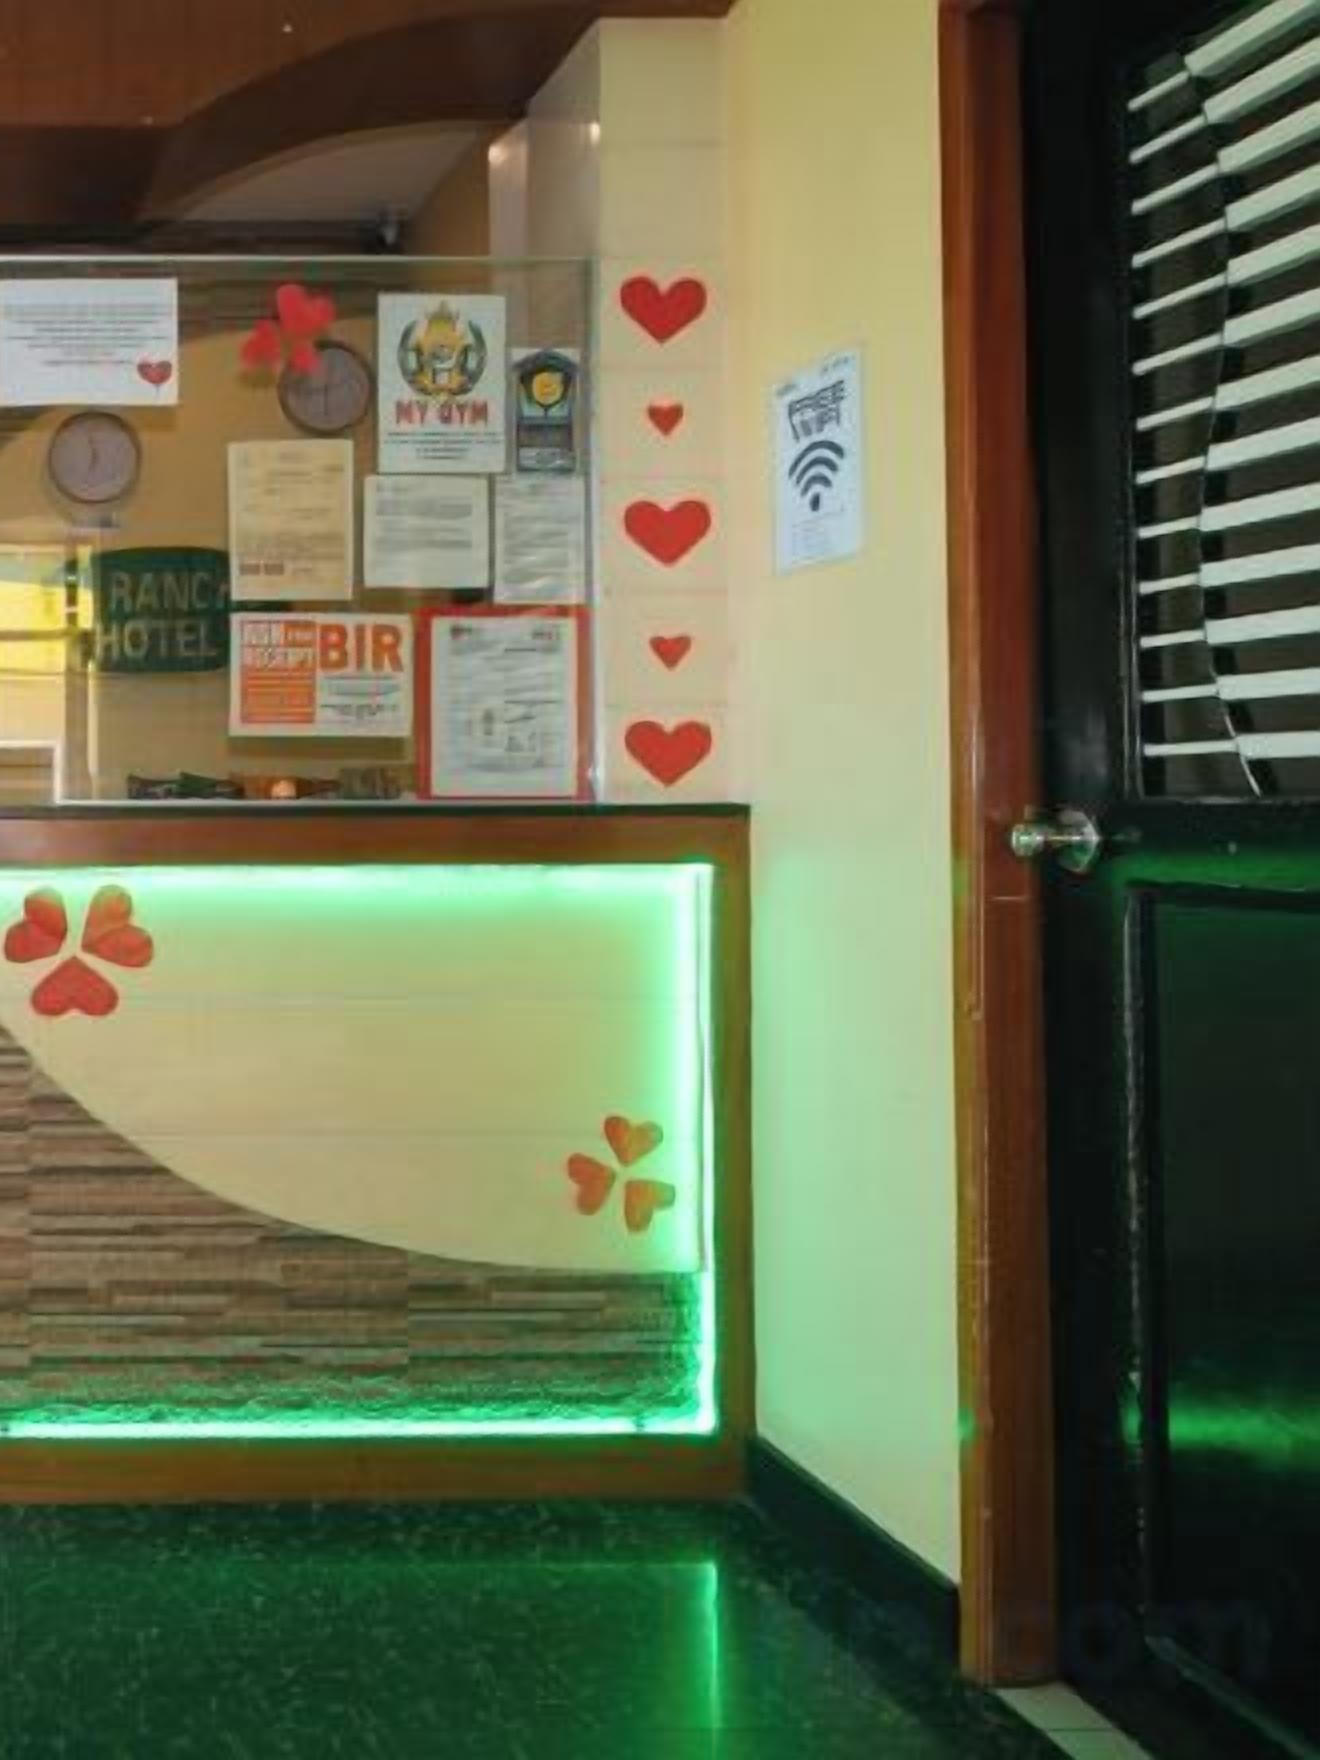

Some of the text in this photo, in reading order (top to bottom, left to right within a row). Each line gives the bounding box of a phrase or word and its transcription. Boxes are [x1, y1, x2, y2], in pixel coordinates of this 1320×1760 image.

[395, 399, 490, 426] MY GYM
[94, 619, 219, 660] HOTEL
[318, 623, 404, 673] BIR
